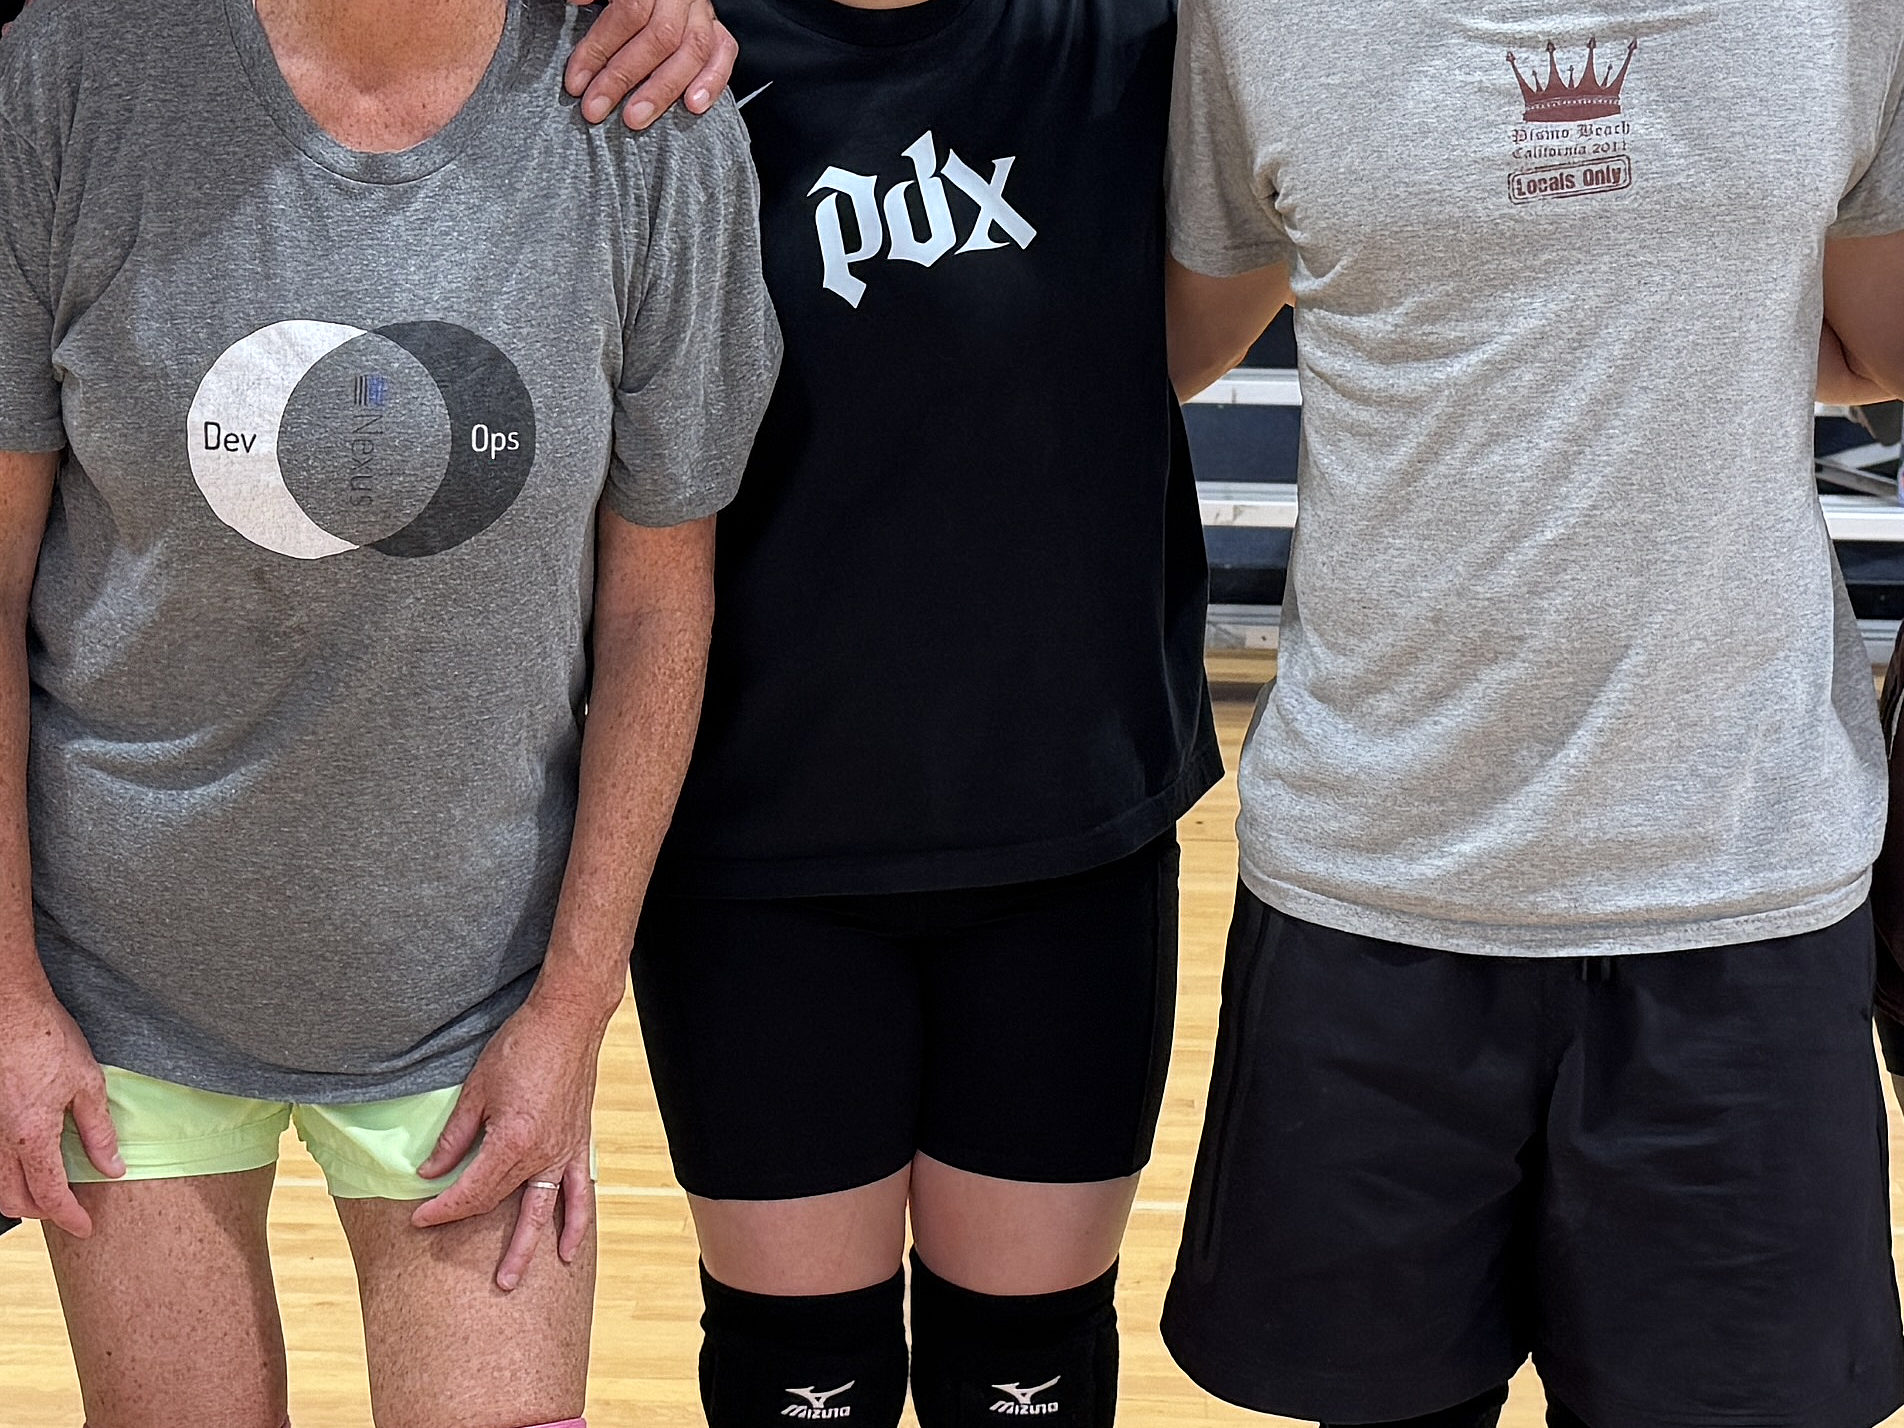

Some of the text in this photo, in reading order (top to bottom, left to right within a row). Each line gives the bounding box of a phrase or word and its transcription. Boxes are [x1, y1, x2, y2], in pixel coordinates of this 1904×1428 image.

[1516, 164, 1622, 197] Locals Only
[807, 130, 1037, 308] pdx
[203, 421, 256, 454] Dev
[471, 424, 520, 459] Ops
